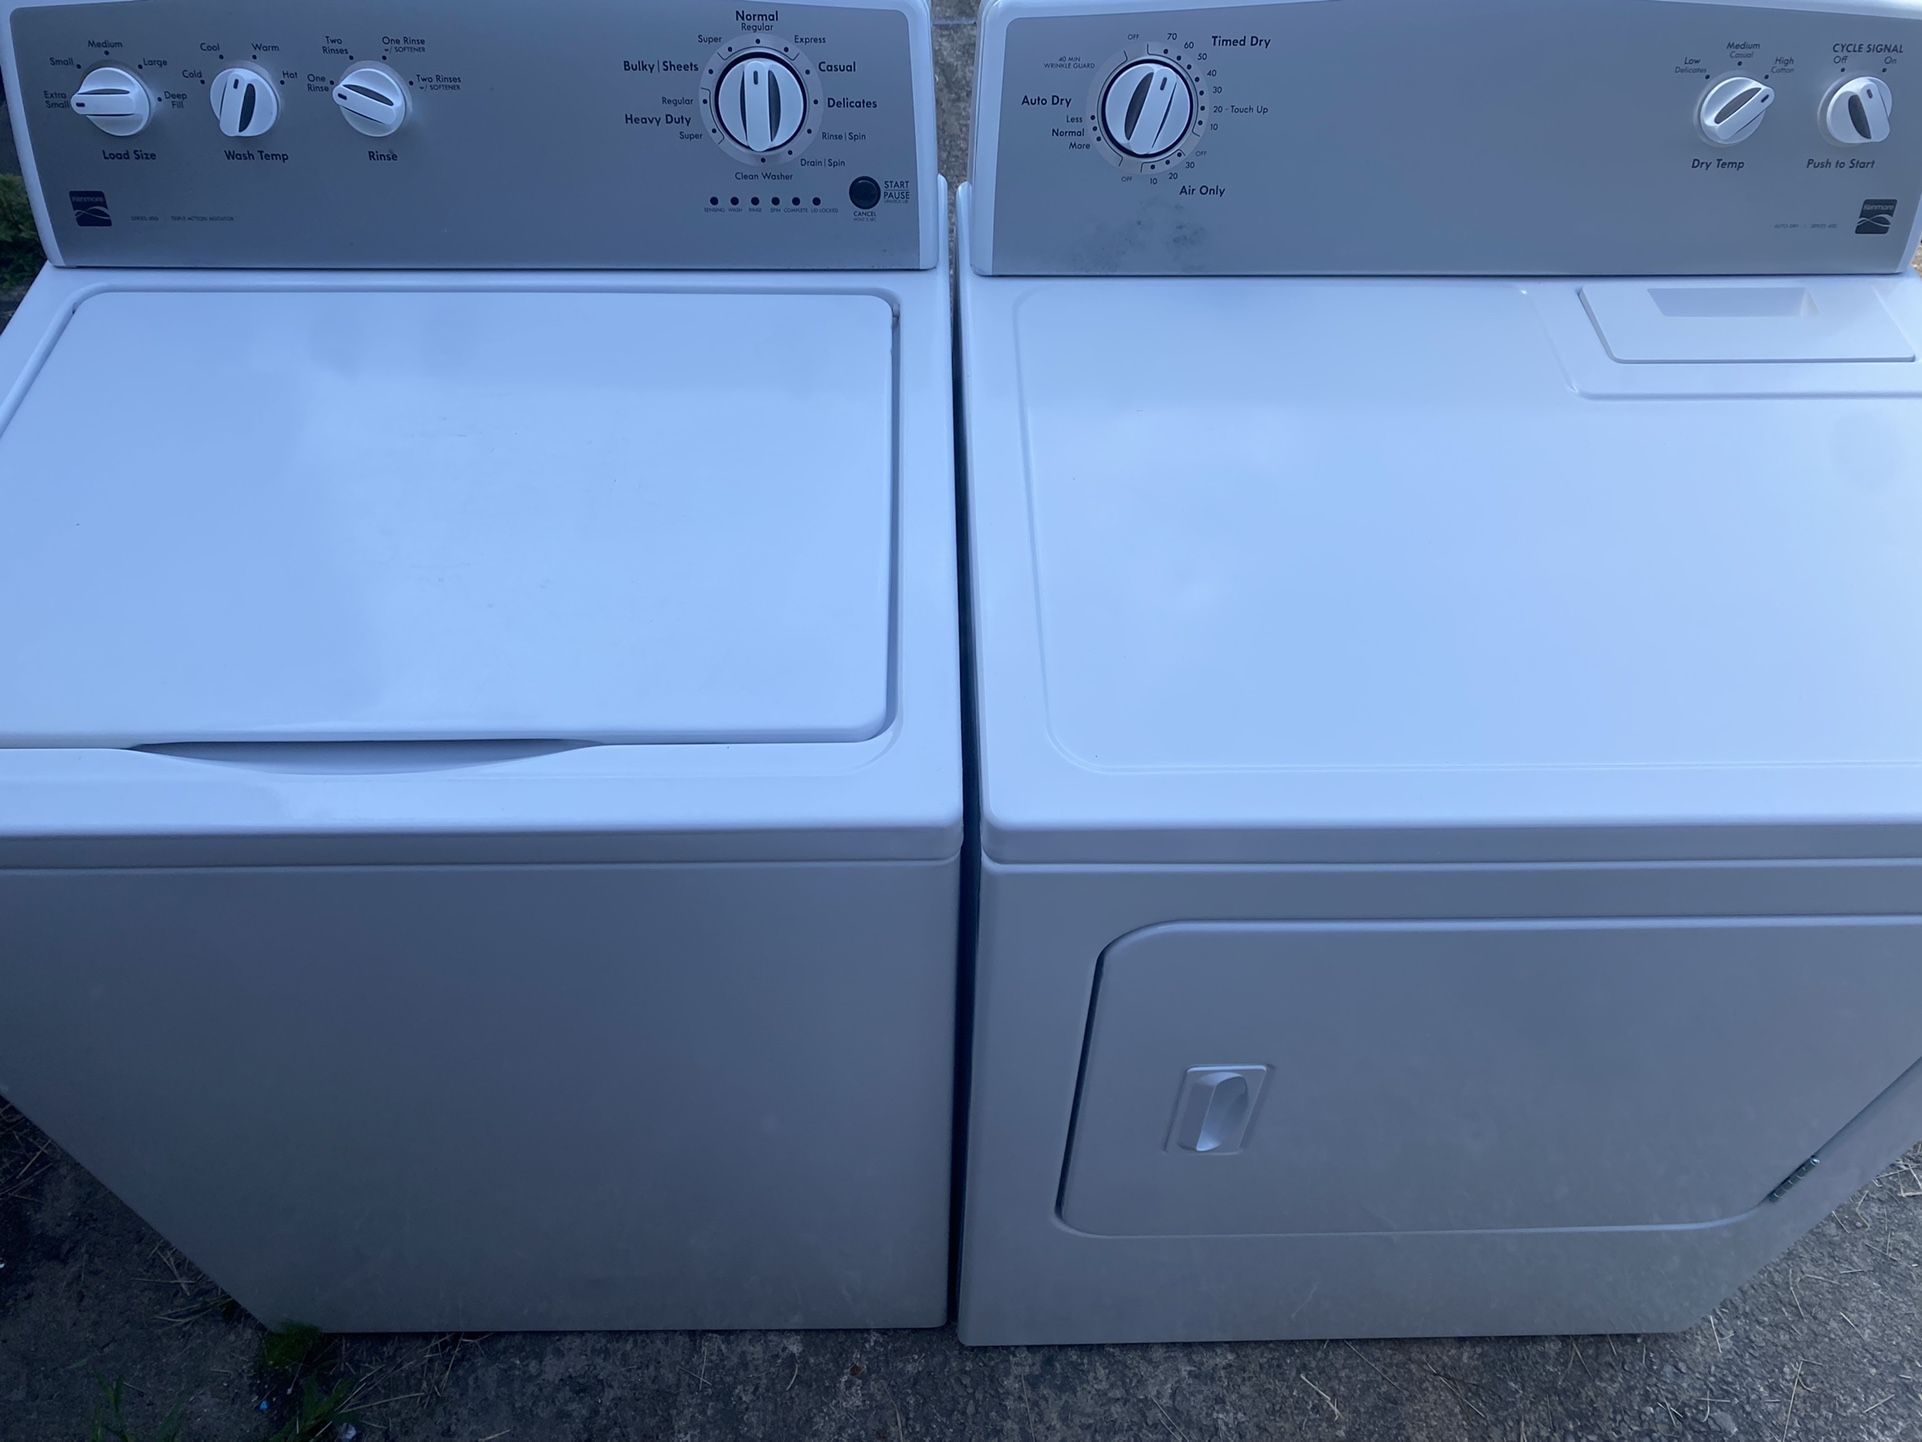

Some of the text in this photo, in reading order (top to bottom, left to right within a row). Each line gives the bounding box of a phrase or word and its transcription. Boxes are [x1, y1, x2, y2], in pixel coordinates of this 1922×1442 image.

[735, 10, 778, 21] Normal
[742, 23, 773, 32] Regular
[325, 37, 342, 45] Two
[382, 36, 425, 45] One Rinse
[698, 35, 722, 44] Super
[794, 35, 826, 44] Express
[1212, 36, 1271, 48] Timed Dry
[322, 47, 348, 55] Rinses
[1833, 44, 1903, 53] CYCLE SIGNAL
[143, 59, 167, 67] Large
[1775, 57, 1794, 66] High
[1833, 56, 1847, 64] Off
[624, 62, 699, 73] Bulky Sheets
[818, 62, 856, 72] Casual
[307, 74, 326, 83] One
[416, 74, 461, 83] Two Rinses
[308, 84, 329, 92] Rinse
[164, 92, 187, 100] Deep
[662, 97, 693, 106] Regular
[827, 98, 877, 108] Delicates
[1021, 95, 1072, 107] Auto Dry
[1257, 106, 1268, 115] Up
[625, 114, 692, 126] Heavy Duty
[680, 132, 702, 141] Super
[822, 132, 866, 142] Rinse Spin
[103, 151, 156, 160] Load Size
[224, 151, 289, 163] Wash Temp
[369, 151, 398, 161] Rinse
[801, 159, 845, 168] Drain Spin
[1691, 159, 1744, 171] Dry Temp
[1807, 159, 1875, 168] Push to Start
[762, 172, 793, 180] Washer
[1179, 186, 1226, 197] Air Only
